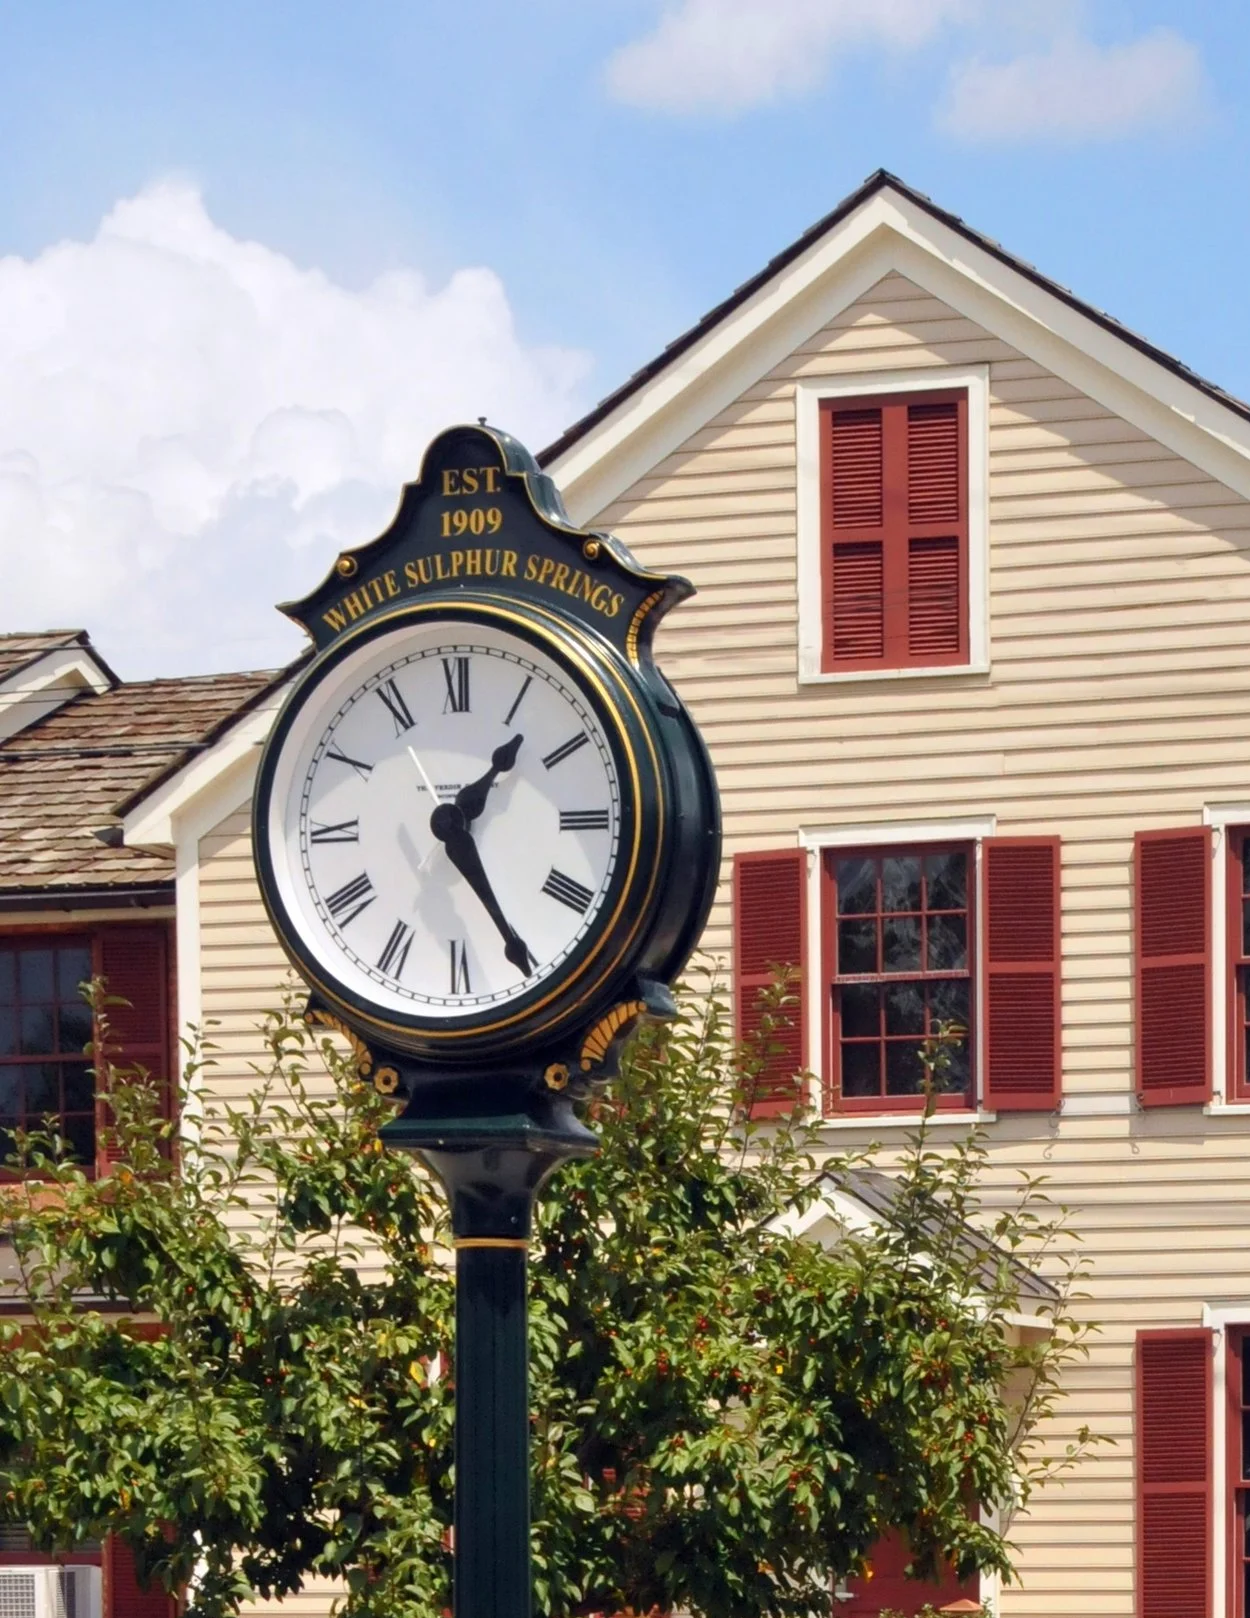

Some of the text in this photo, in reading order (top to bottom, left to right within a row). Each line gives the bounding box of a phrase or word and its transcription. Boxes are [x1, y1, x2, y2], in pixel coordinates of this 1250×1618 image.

[442, 466, 501, 496] EST.
[441, 507, 503, 537] 1909
[322, 549, 625, 633] WHITE SULPHUR SPRINGS
